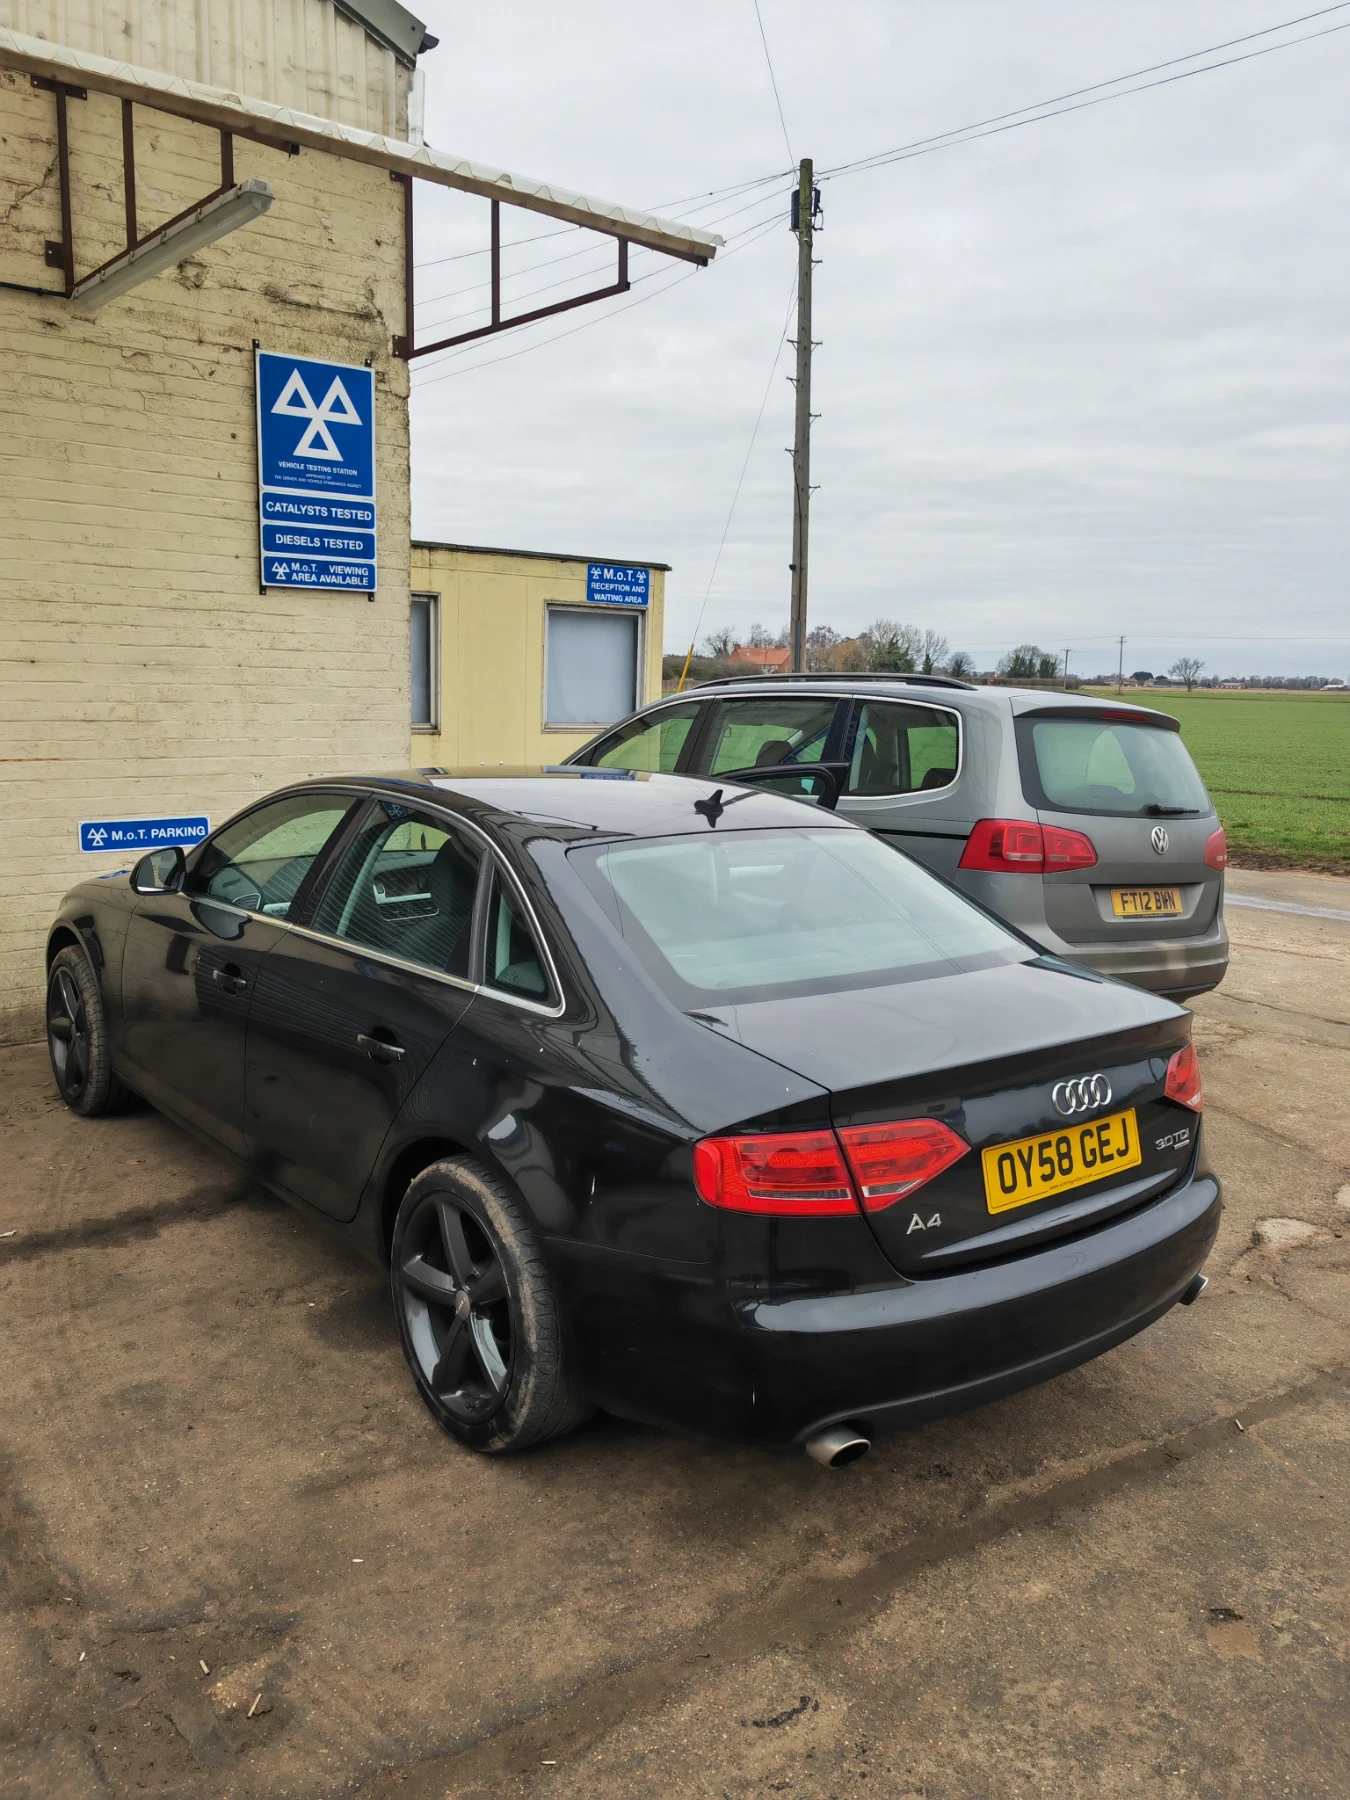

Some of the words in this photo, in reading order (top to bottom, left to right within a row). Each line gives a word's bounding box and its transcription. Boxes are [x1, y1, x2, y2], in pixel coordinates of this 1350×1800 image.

[278, 461, 304, 470] VEHICLE
[306, 464, 331, 472] TESTING
[333, 468, 358, 476] STATION
[266, 501, 328, 516] CATALYSTS
[330, 508, 372, 520] TESTED
[275, 534, 320, 548] DIESELS
[323, 538, 364, 550] TESTED
[291, 562, 318, 573] M.o.T.
[329, 564, 368, 576] VIEWING
[603, 568, 634, 582] M.o.T.
[291, 572, 318, 582] AREA
[319, 574, 369, 586] AVAILABLE
[591, 582, 630, 592] RECEPTION
[594, 593, 622, 602] WAITING
[624, 596, 642, 604] AREA
[111, 829, 148, 841] M.o.T.
[151, 826, 206, 839] PARKING
[1120, 892, 1152, 911] FT12
[997, 1139, 1074, 1195] OY58
[1079, 1118, 1130, 1170] GEJ
[906, 1212, 942, 1234] A4
